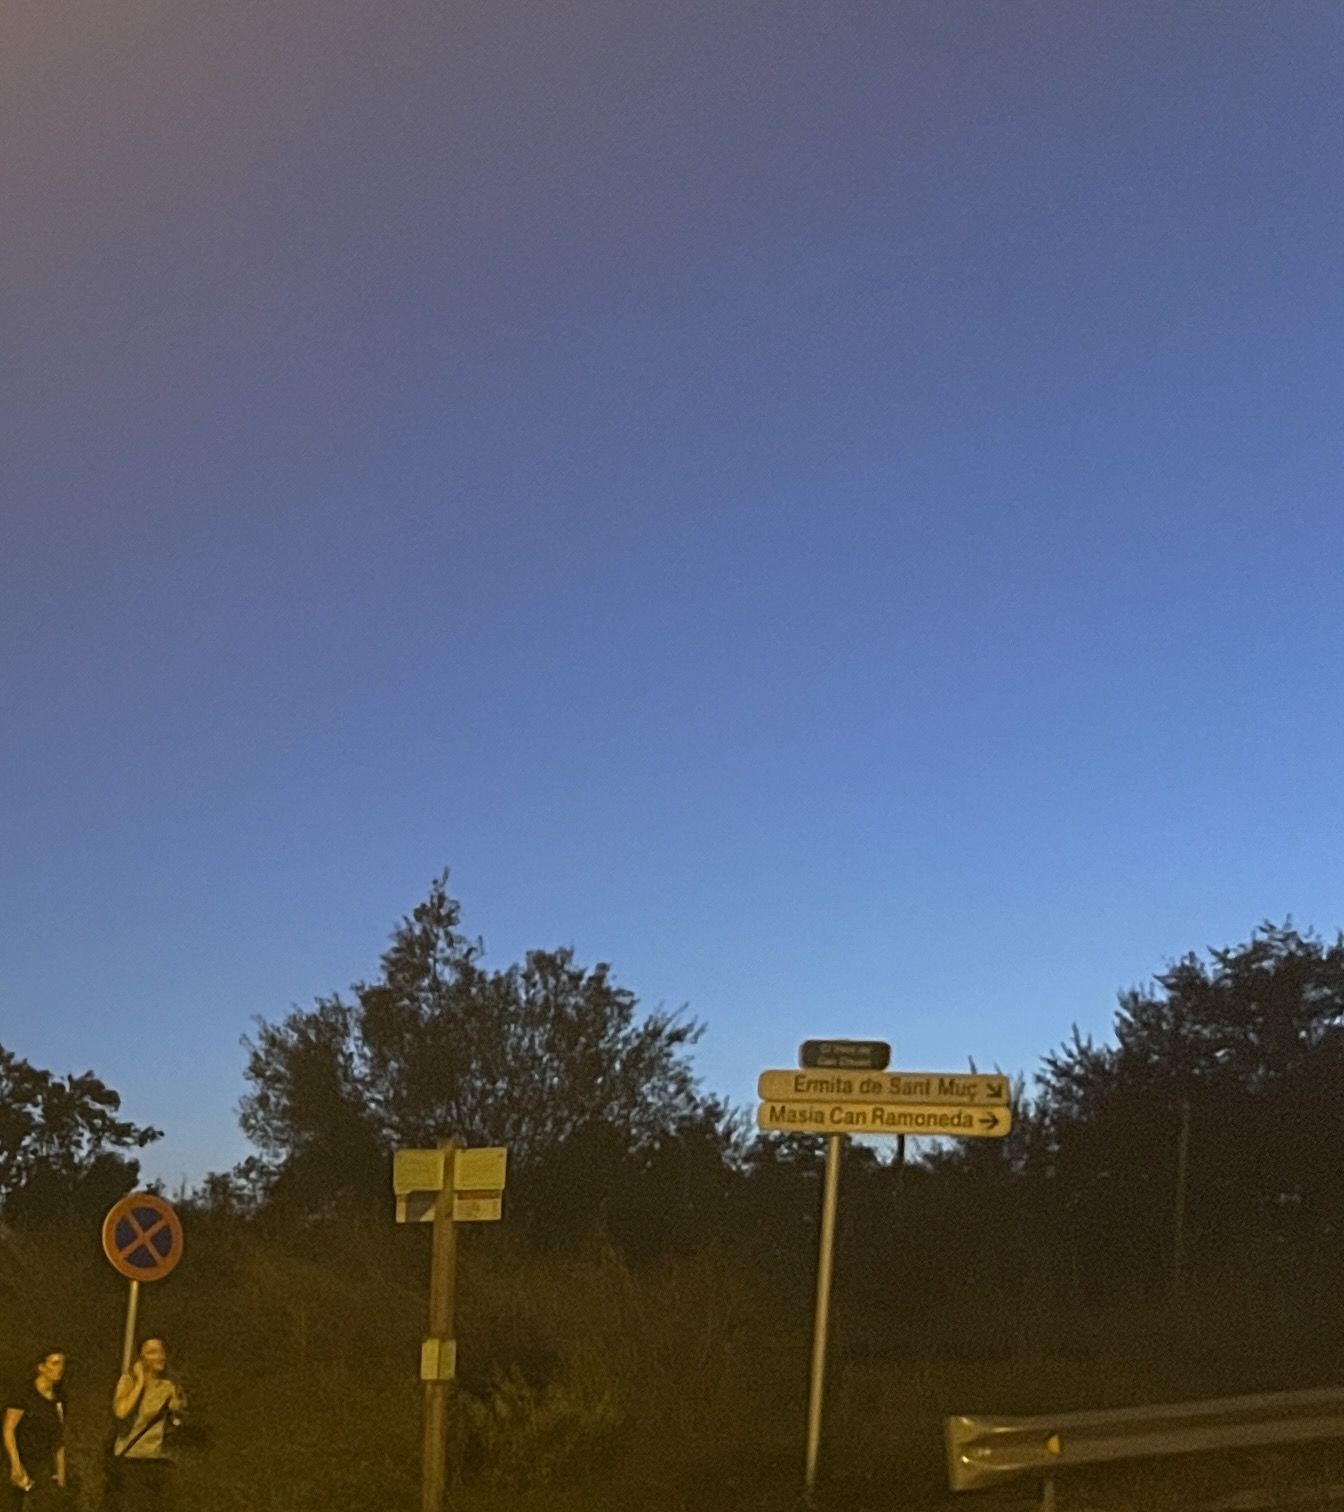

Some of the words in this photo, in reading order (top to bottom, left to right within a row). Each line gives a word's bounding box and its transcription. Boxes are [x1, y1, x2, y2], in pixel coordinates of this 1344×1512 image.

[794, 1074, 853, 1095] Ermita
[859, 1077, 883, 1095] de
[889, 1076, 930, 1096] Sant
[937, 1077, 977, 1101] Muç
[829, 1106, 867, 1125] Can
[871, 1107, 974, 1128] Ramoneda
